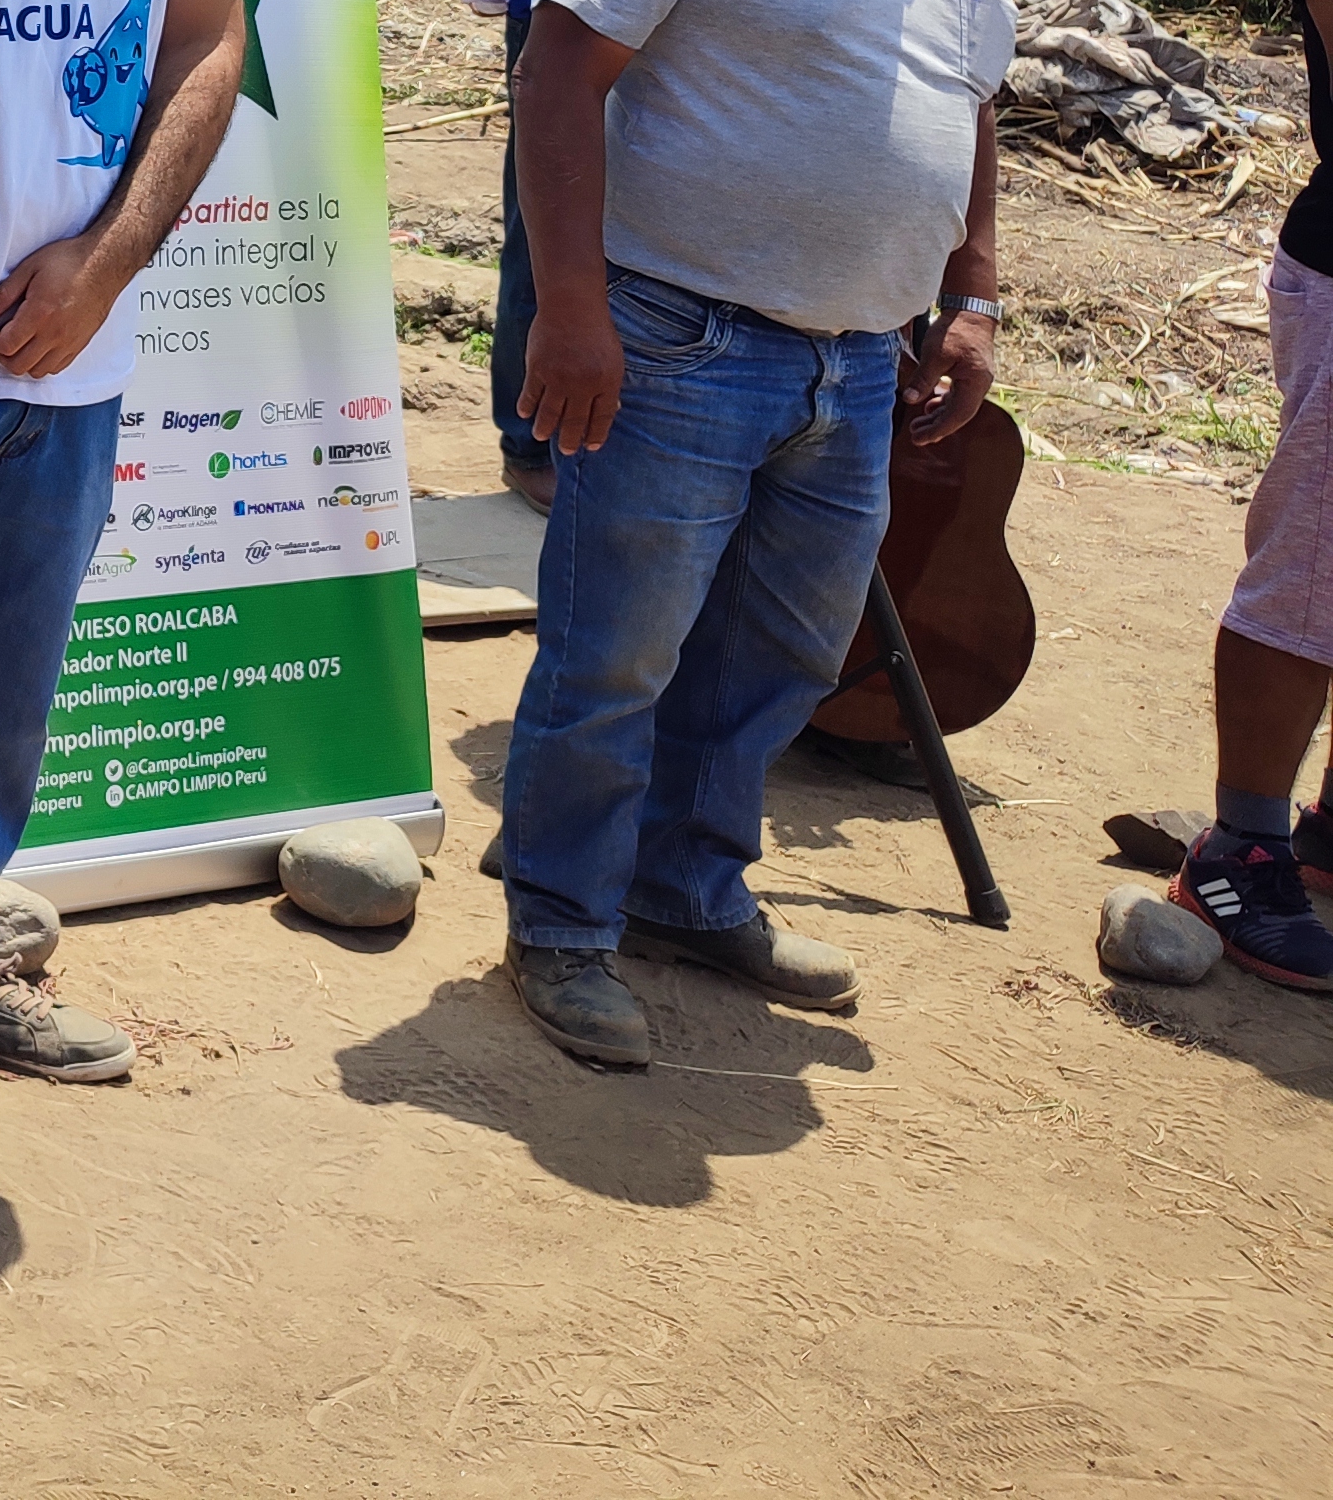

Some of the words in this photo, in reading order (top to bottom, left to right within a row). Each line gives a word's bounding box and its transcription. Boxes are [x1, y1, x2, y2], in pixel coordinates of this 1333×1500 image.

[174, 195, 270, 232] partida
[279, 200, 308, 220] es
[319, 193, 339, 219] la
[215, 235, 314, 269] integral
[324, 241, 337, 267] y
[140, 287, 231, 311] nvases
[240, 275, 325, 305] vacíos
[135, 326, 209, 354] micos
[118, 411, 145, 426] ASF
[162, 411, 220, 433] Biogen
[348, 396, 391, 420] DUPONT
[115, 463, 145, 482] MC
[233, 451, 288, 469] hortus
[155, 545, 225, 573] syngenta
[68, 616, 130, 642] VIESO
[135, 605, 237, 635] ROALCABA
[118, 646, 172, 669] Norte
[177, 642, 187, 662] II
[50, 675, 217, 713] mpolimpio.org.pe
[222, 669, 229, 690] /
[233, 665, 267, 687] 994
[271, 661, 304, 682] 408
[309, 657, 340, 678] 075
[43, 716, 225, 757] mpolimpio.org.pe
[125, 746, 267, 779] @CampoLimpioPeru
[36, 767, 93, 792] pioperu
[126, 779, 180, 800] CAMPO
[183, 772, 232, 793] LIMPIO
[235, 767, 267, 786] Perú
[30, 796, 82, 815] ioperu
